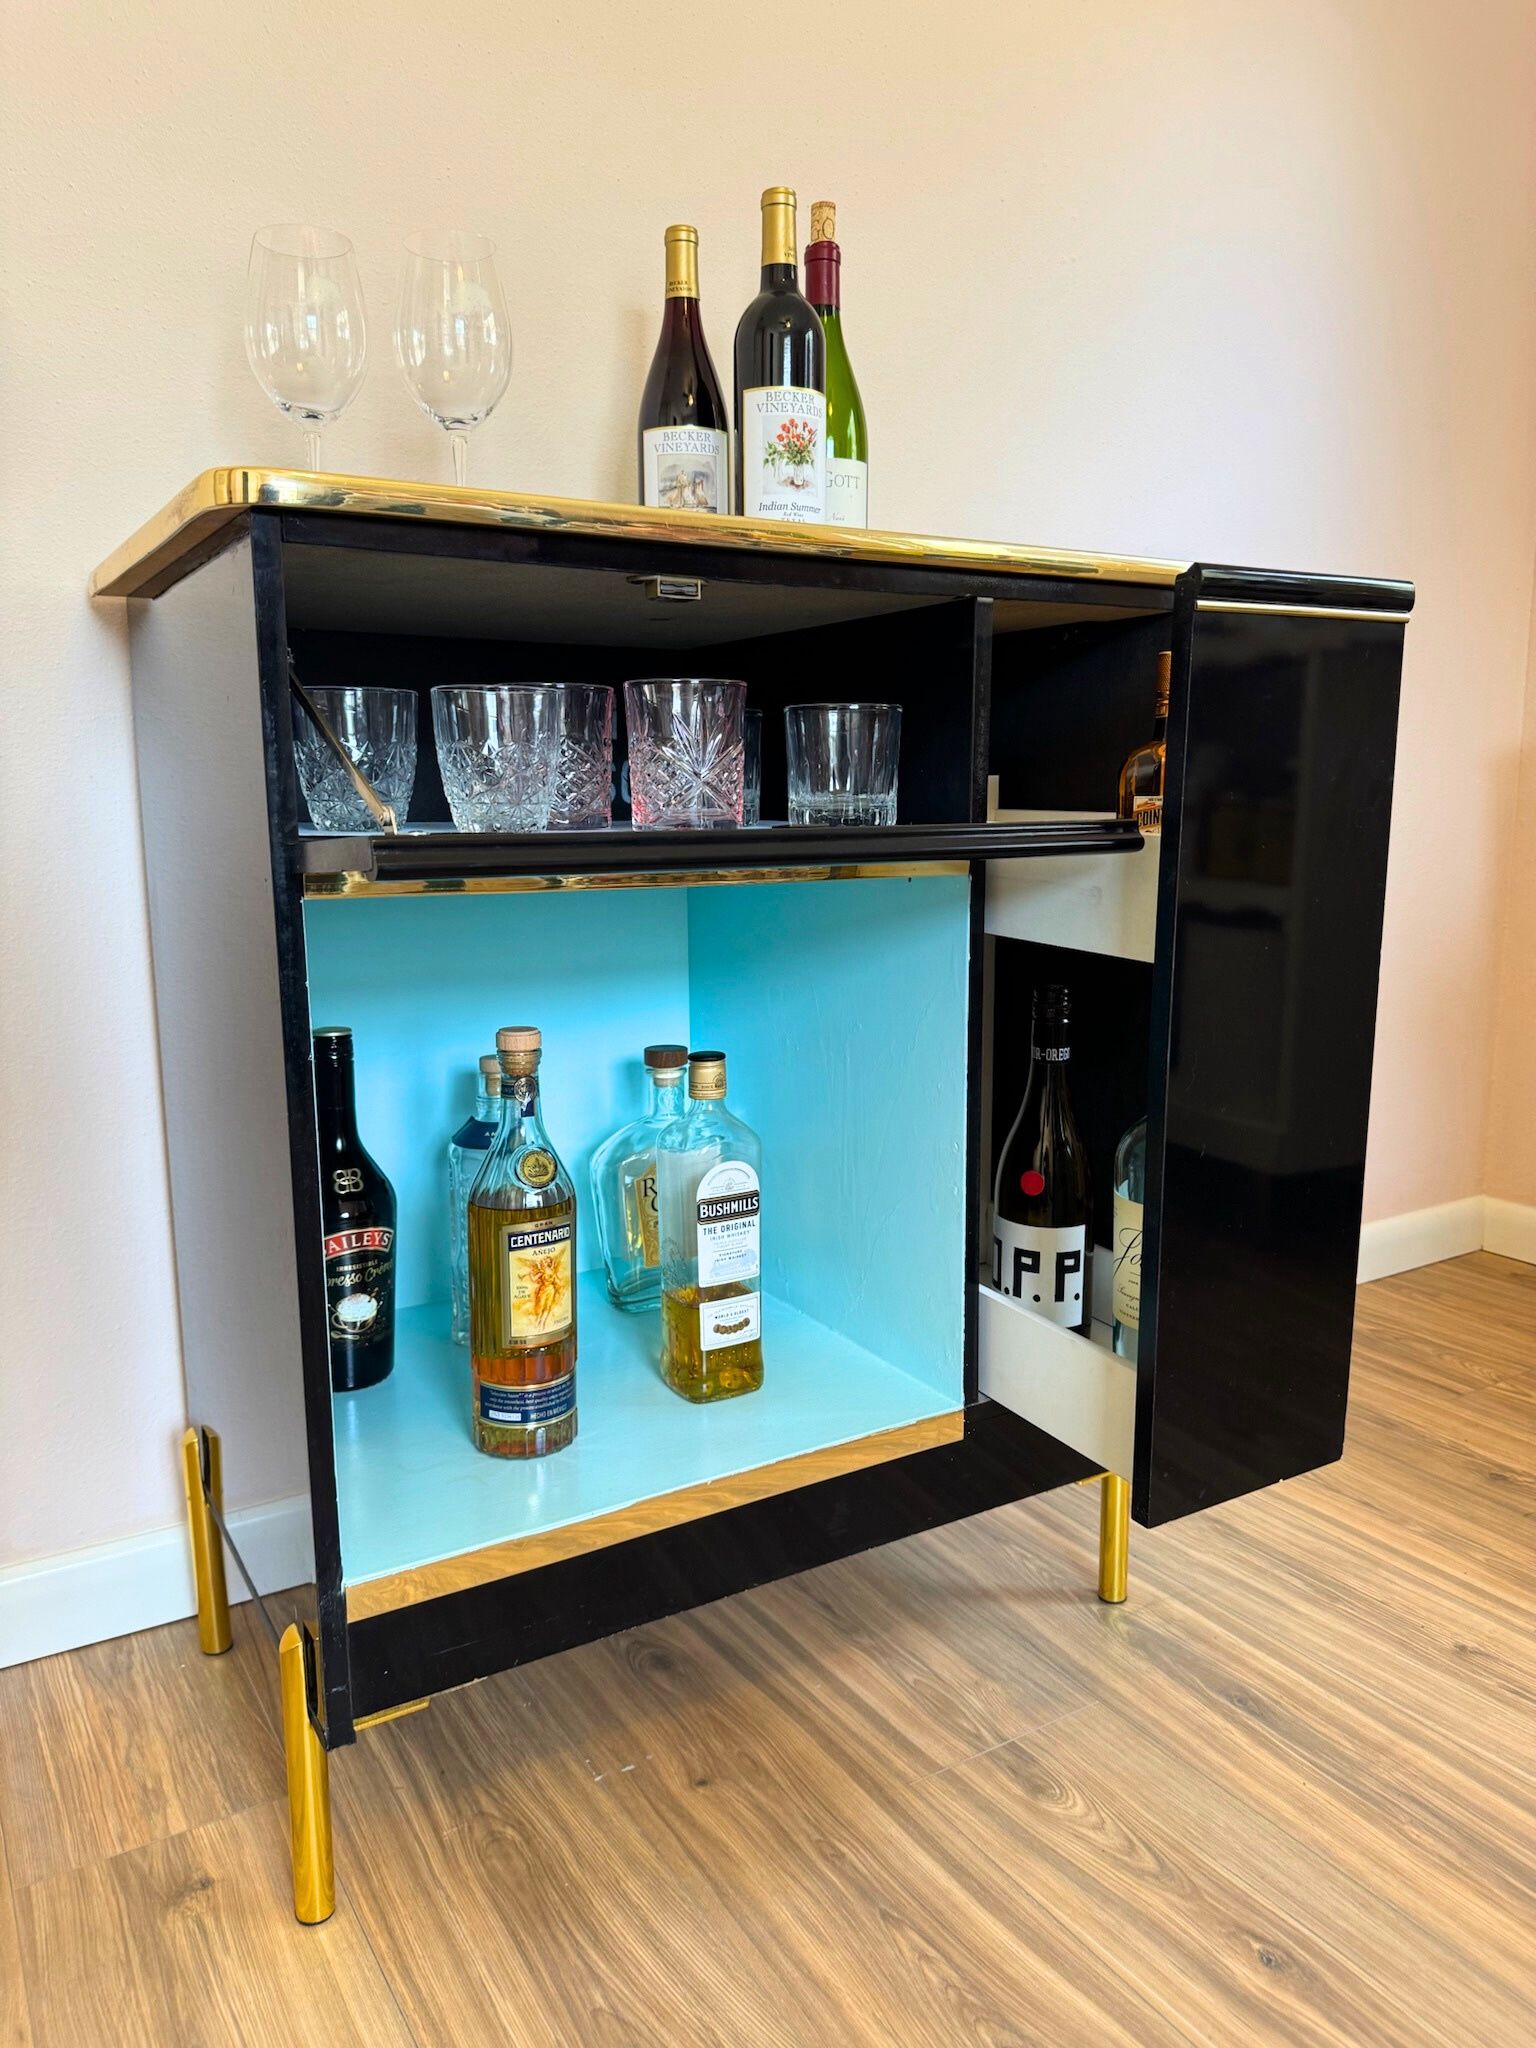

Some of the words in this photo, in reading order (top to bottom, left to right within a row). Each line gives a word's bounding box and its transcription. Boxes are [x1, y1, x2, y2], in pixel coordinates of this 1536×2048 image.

[766, 391, 815, 405] BECKER
[757, 402, 823, 418] VINEYARDS
[663, 431, 711, 443] BECKER
[654, 442, 720, 455] VINEYARDS
[825, 470, 861, 489] GOTT
[758, 501, 788, 511] Indian
[790, 502, 822, 514] Summer
[699, 1197, 759, 1218] BUSHMILLS
[703, 1227, 717, 1236] THE
[720, 1219, 756, 1233] ORIGINAL
[326, 1231, 391, 1254] AILEYS
[510, 1226, 570, 1248] CENTENARIO
[532, 1247, 556, 1256] AÑEJO
